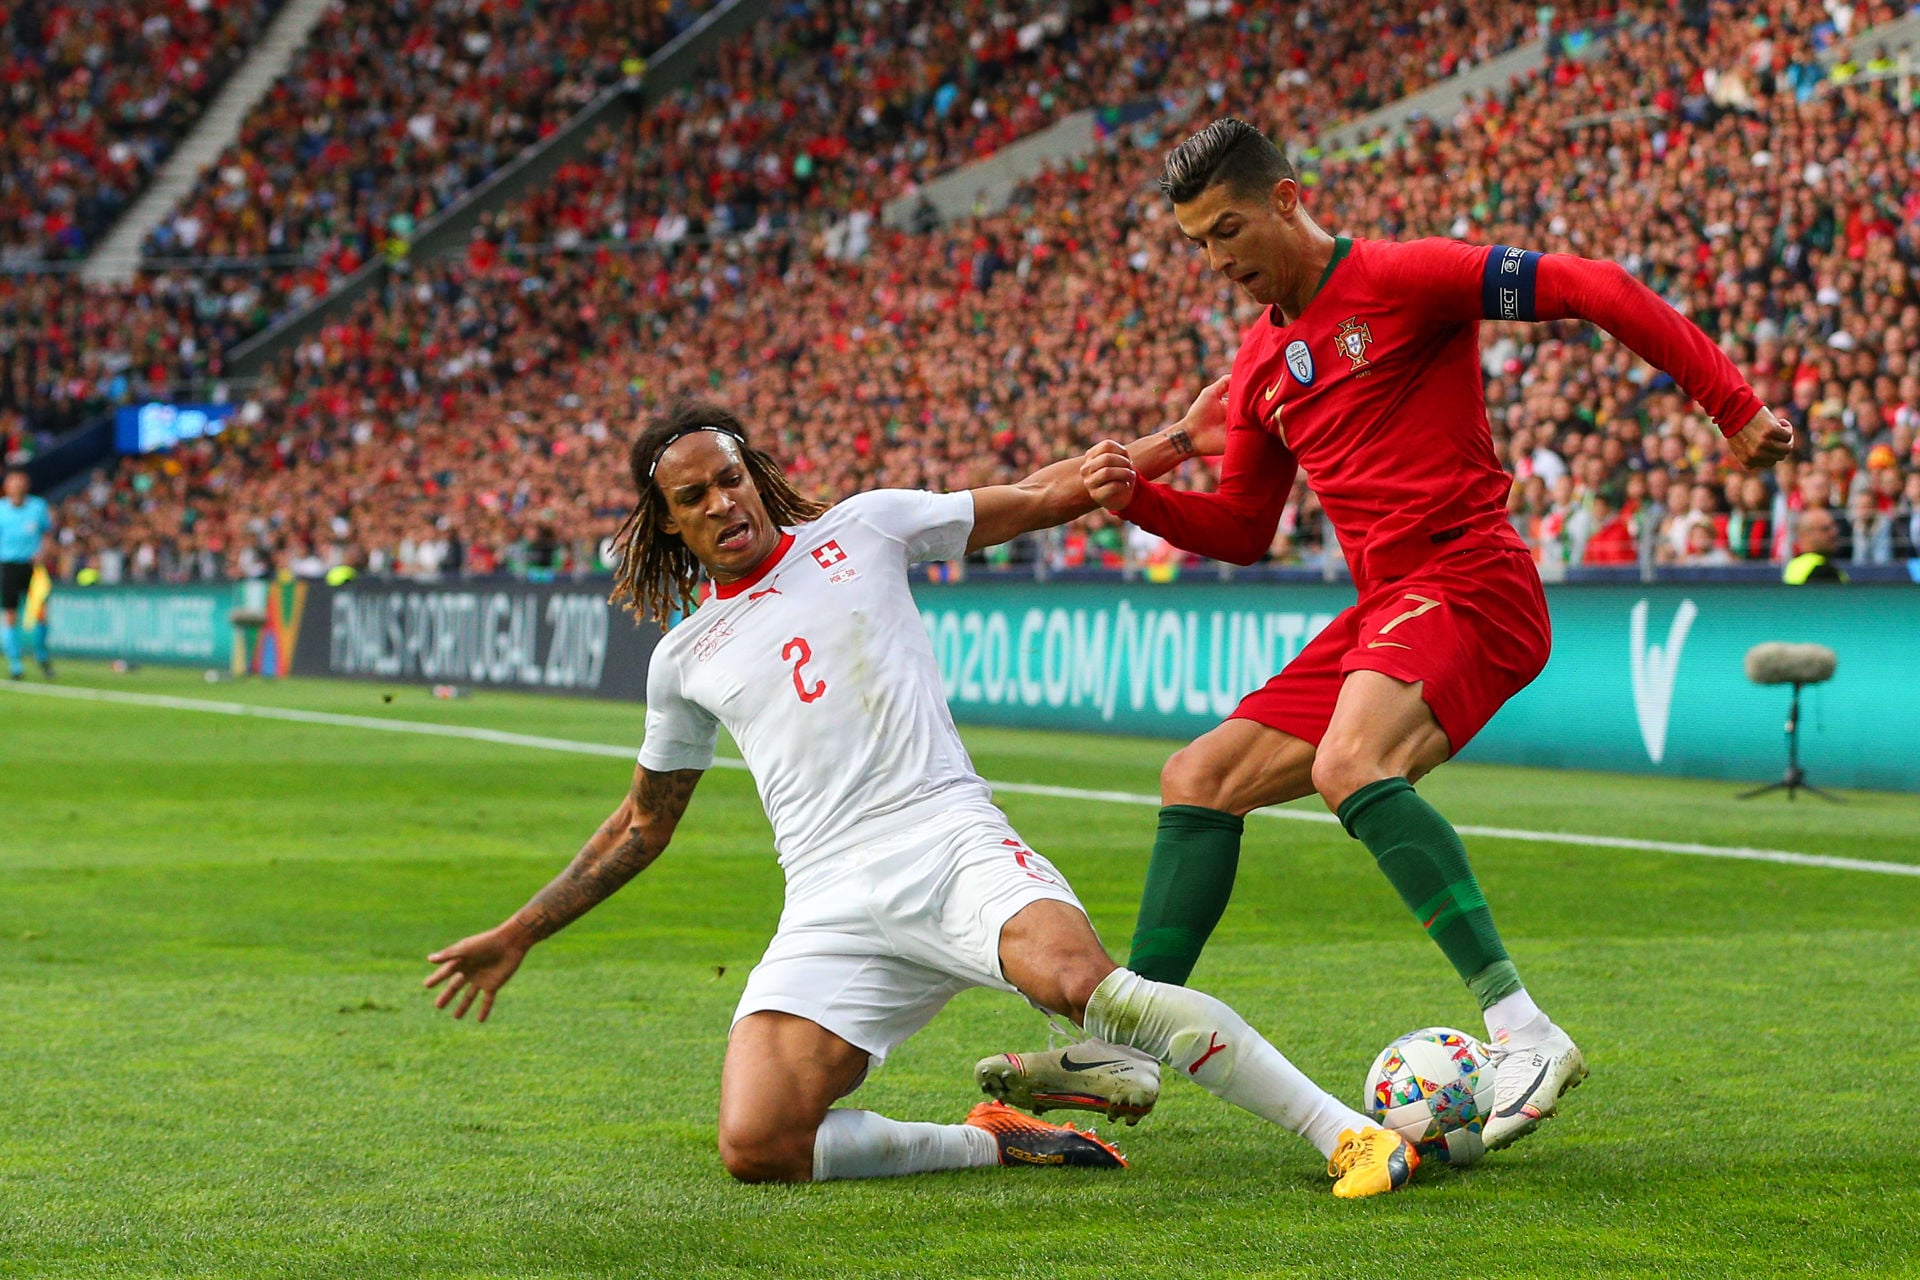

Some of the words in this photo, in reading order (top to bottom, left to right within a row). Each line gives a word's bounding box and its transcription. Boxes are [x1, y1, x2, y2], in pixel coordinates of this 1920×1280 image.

[330, 591, 400, 675] FINALS
[402, 592, 543, 684] PORTUGAL
[544, 592, 609, 688] 2019
[1378, 593, 1442, 634] 7
[780, 636, 827, 704] 2
